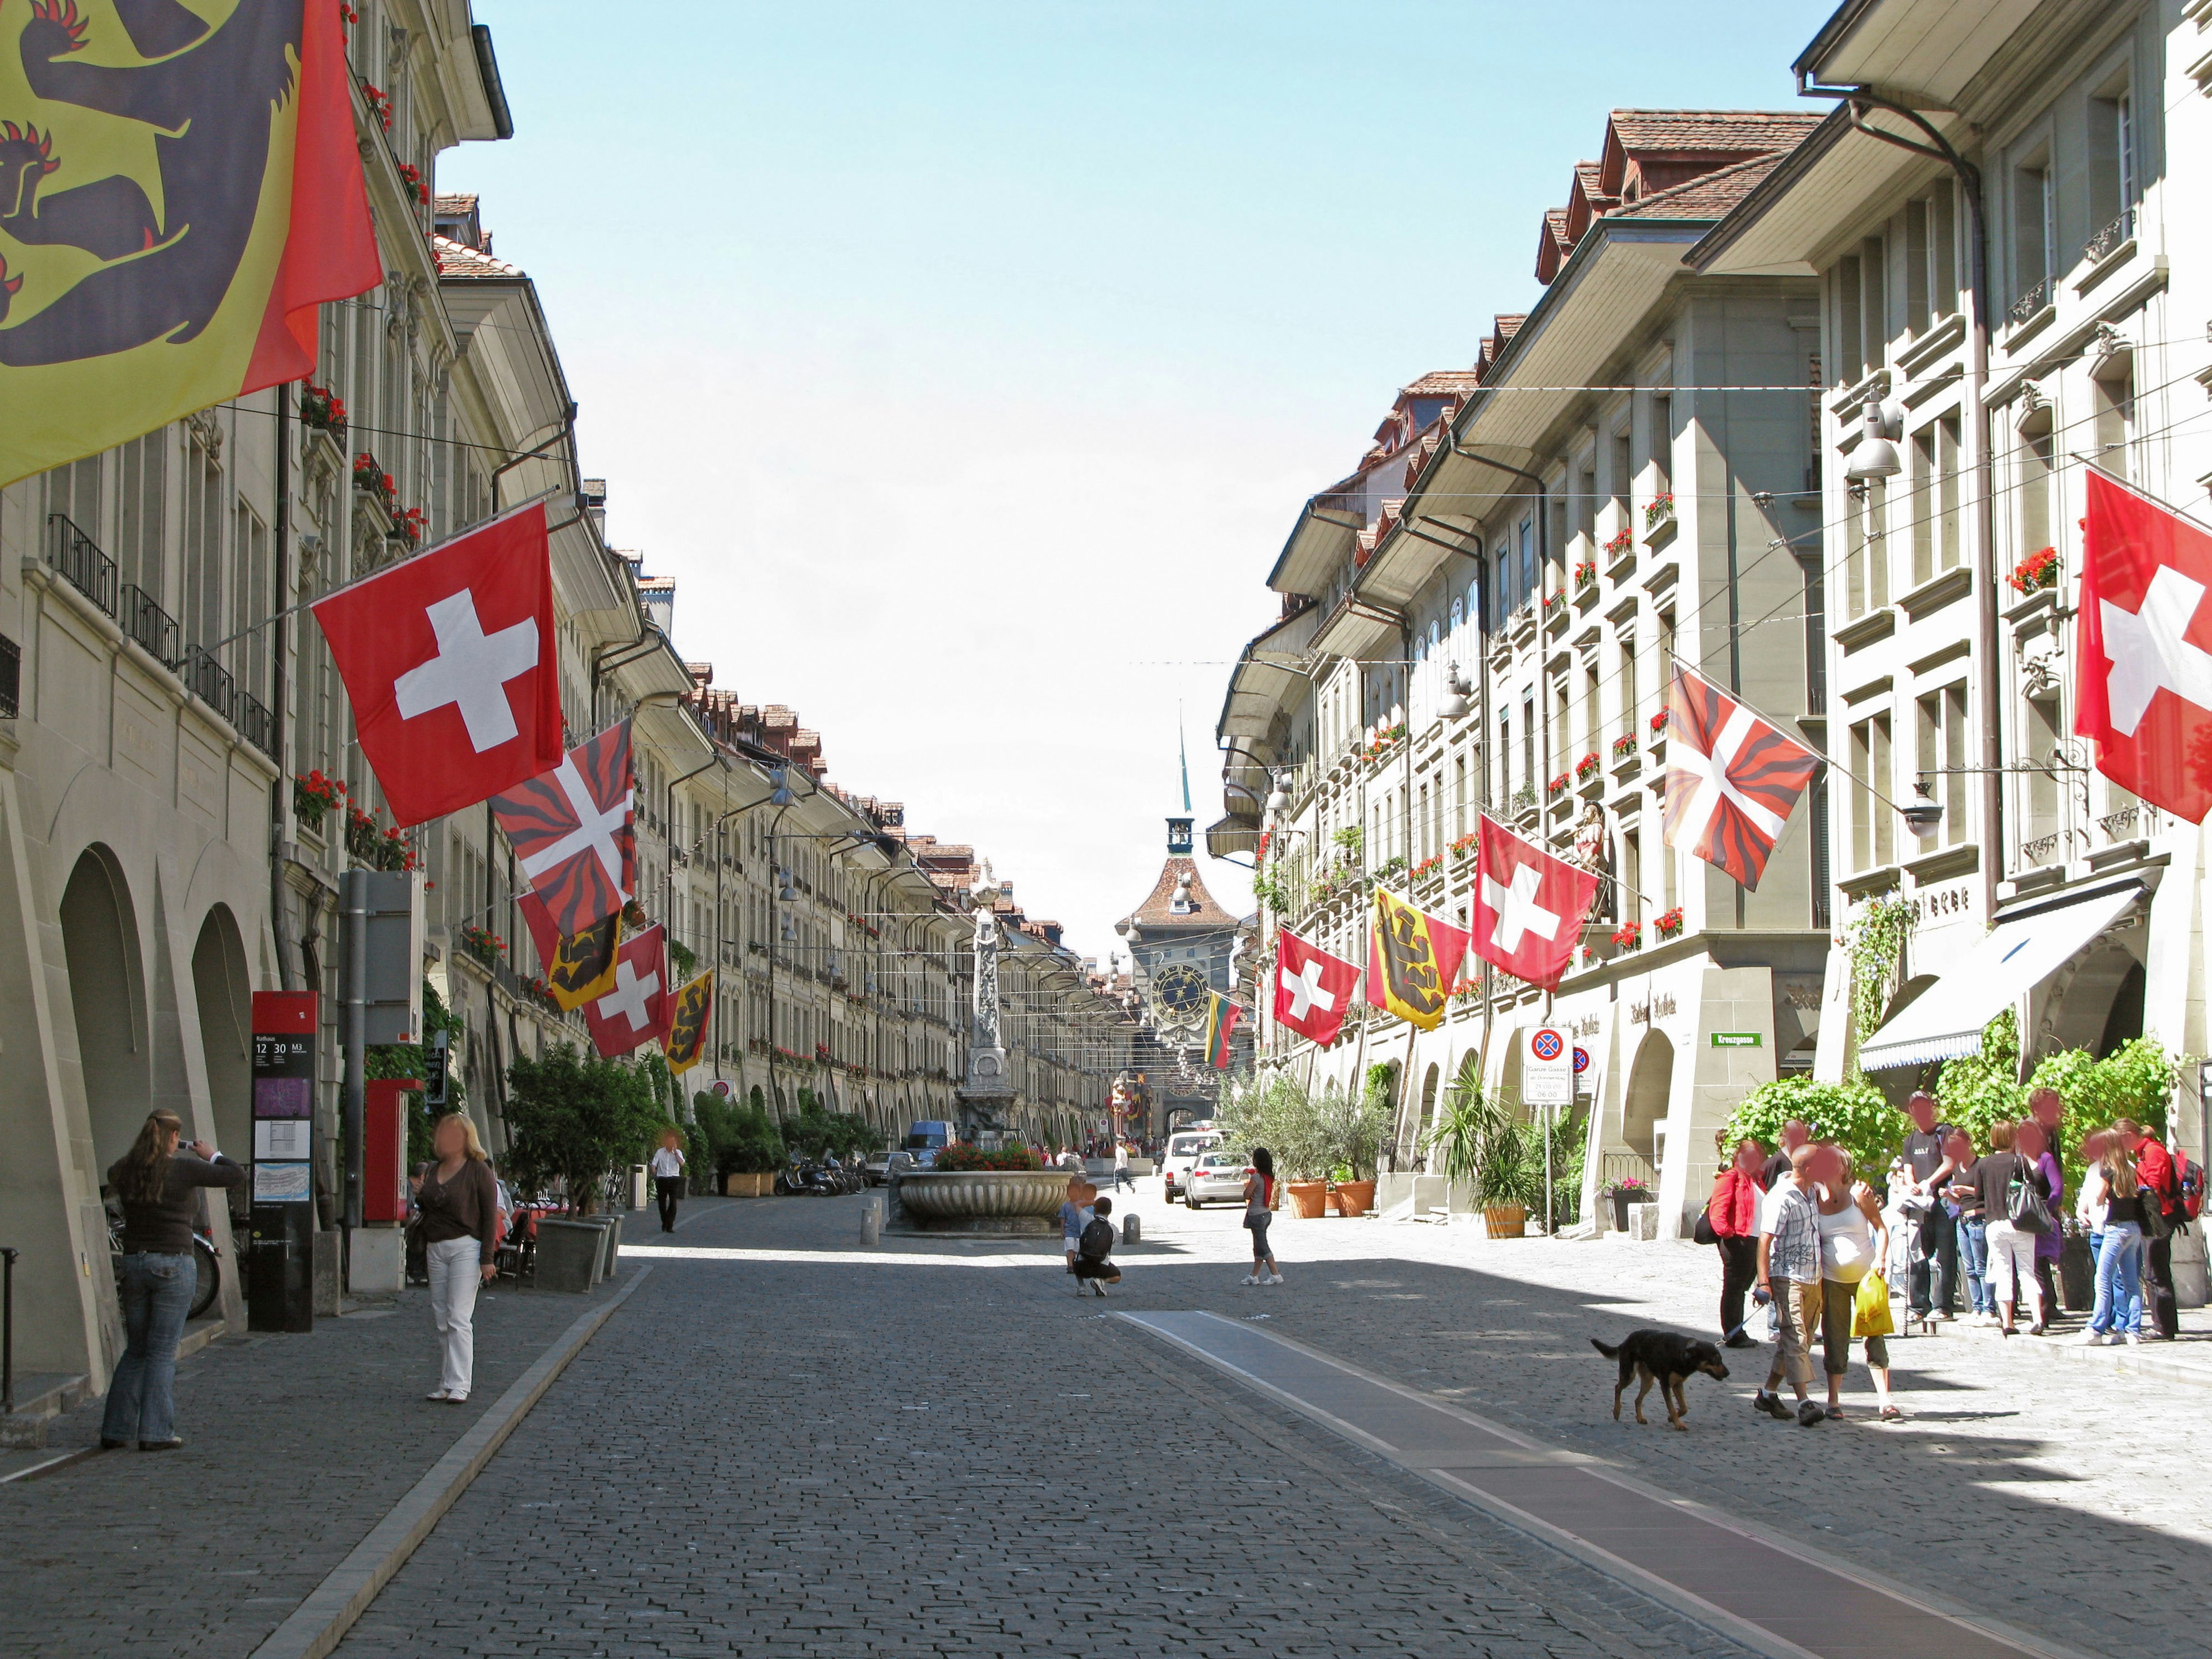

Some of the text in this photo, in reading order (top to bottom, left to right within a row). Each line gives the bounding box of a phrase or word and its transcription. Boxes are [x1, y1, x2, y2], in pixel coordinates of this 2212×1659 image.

[1718, 1035, 1754, 1046] Kreuzgasse
[256, 1043, 267, 1054] 12
[274, 1043, 286, 1054] 30
